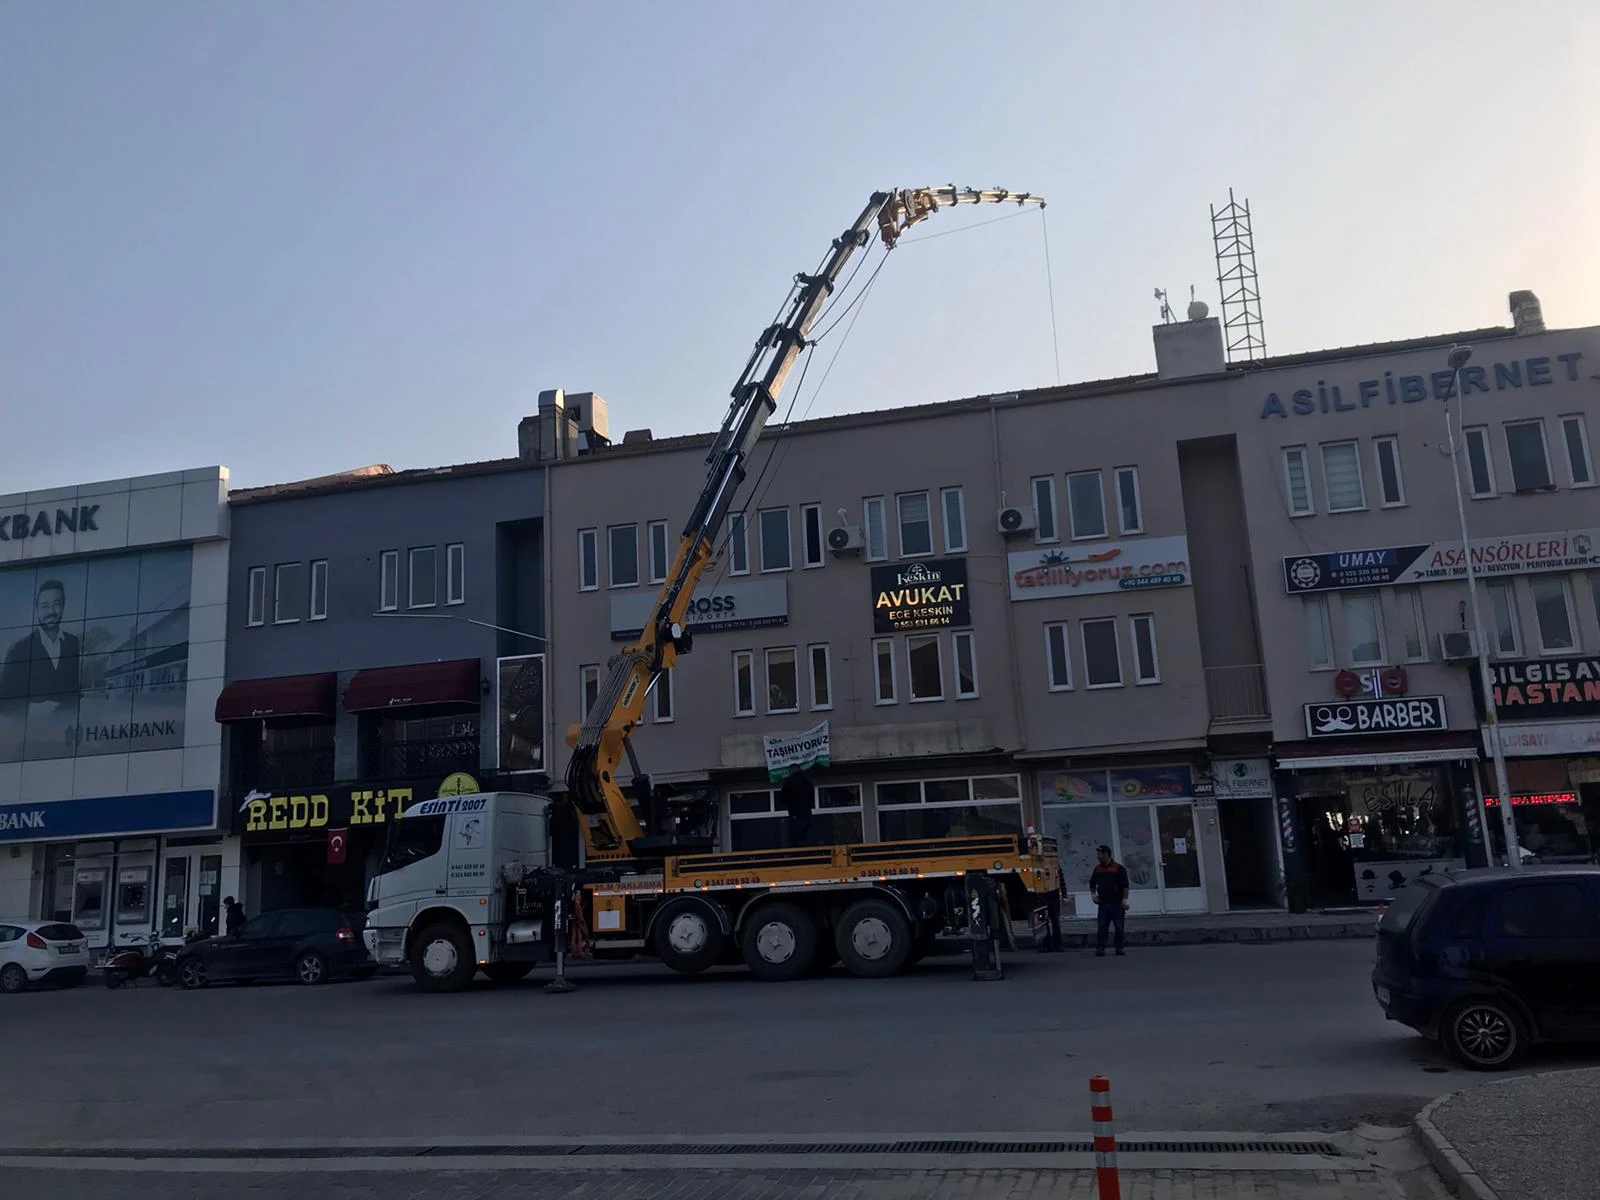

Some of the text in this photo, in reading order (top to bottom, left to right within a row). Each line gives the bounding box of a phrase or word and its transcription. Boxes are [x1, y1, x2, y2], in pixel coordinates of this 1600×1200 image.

[1340, 551, 1386, 567] UMAY
[1431, 538, 1568, 567] ASANSÖRLERİ
[876, 584, 964, 609] AVUKAT
[1357, 702, 1436, 730] BARBER
[85, 719, 176, 742] HALKBANK
[767, 735, 829, 758] TAŞINIYORUZ
[246, 794, 330, 831] REDD
[461, 799, 487, 811] 2007
